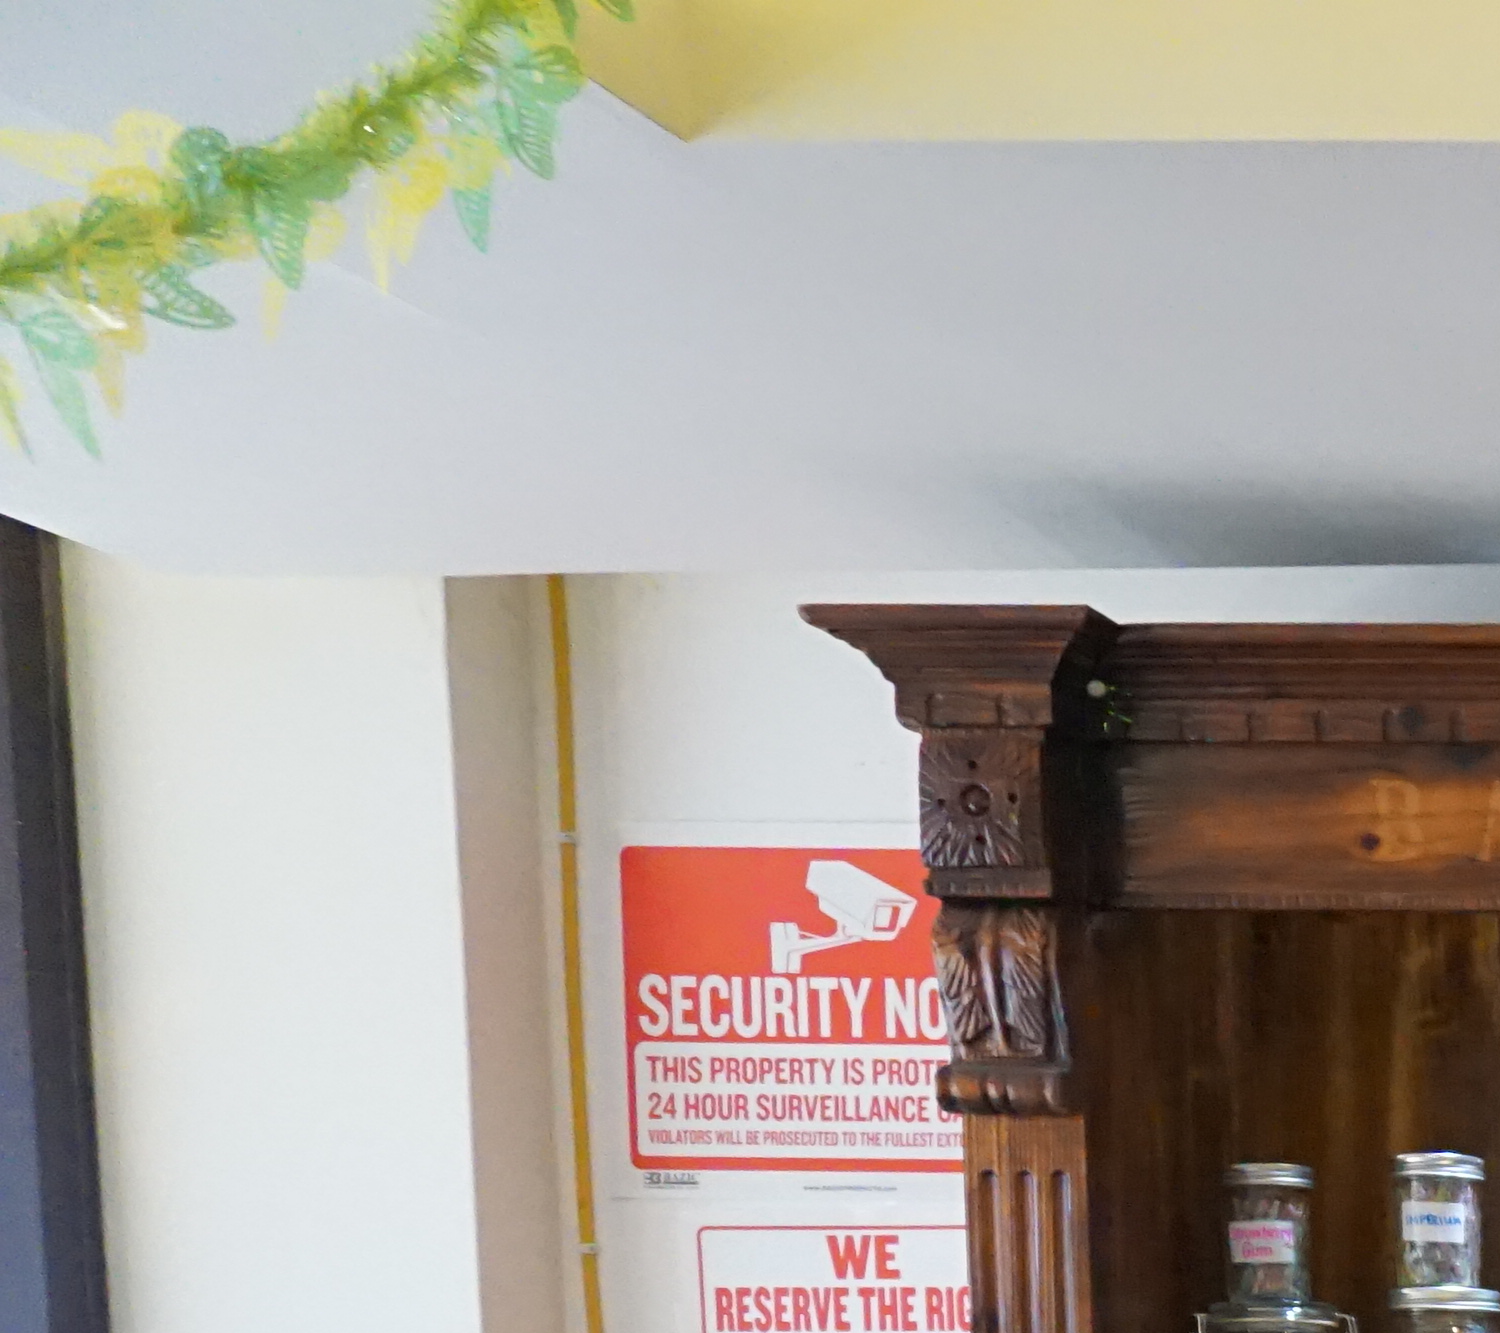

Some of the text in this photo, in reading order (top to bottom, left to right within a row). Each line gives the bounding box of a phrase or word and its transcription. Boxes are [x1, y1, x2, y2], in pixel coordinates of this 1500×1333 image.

[637, 972, 949, 1041] SECURITY NO
[645, 1055, 865, 1086] THIS PROPERTY IS
[647, 1091, 677, 1121] 24
[684, 1092, 750, 1122] HOUR
[756, 1093, 930, 1124] SURVEILLANCE
[647, 1129, 935, 1148] VIOLATORS WILL BE PROSECUTED TO THE FULLEST
[826, 1234, 902, 1280] WE
[714, 1286, 852, 1332] RESERVE
[857, 1286, 918, 1332] THE
